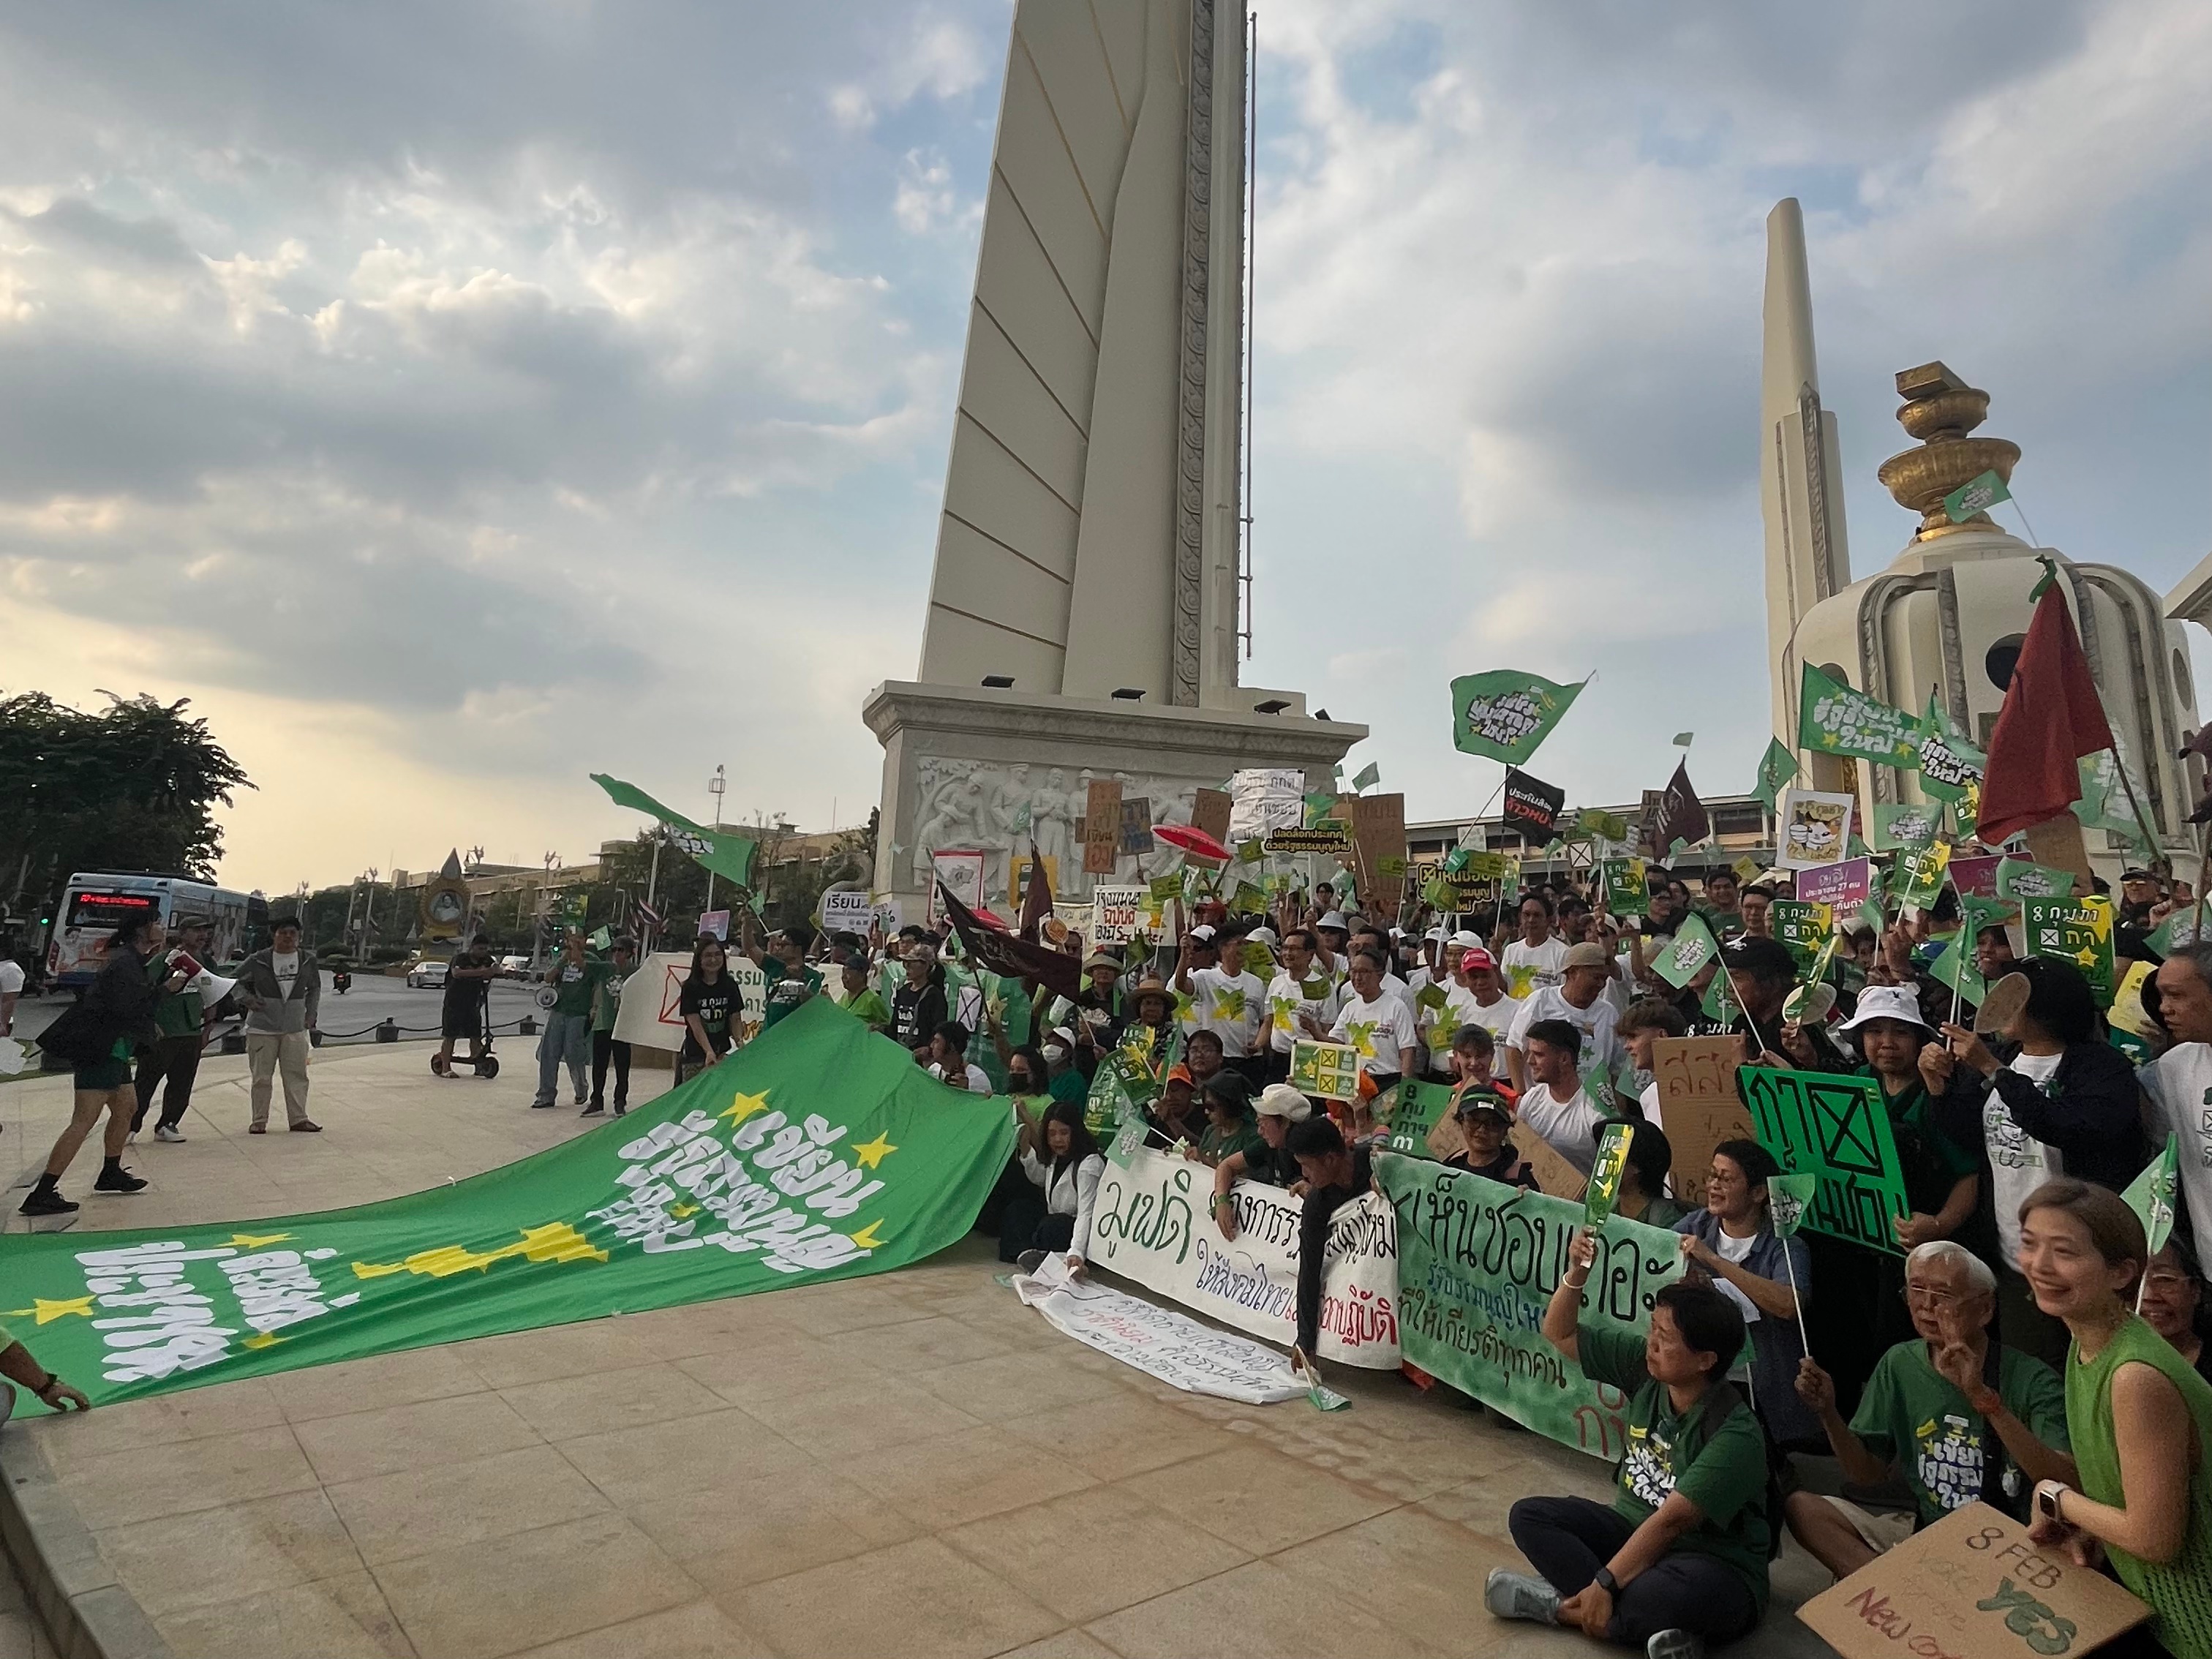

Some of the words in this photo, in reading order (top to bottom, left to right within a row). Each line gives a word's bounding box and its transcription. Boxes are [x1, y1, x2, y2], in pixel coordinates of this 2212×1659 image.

[1778, 908, 1786, 920] 8
[2032, 906, 2043, 922] 8
[2049, 907, 2099, 928] กุมภา
[1801, 925, 1821, 937] กา
[2066, 930, 2096, 946] กา
[1404, 1084, 1418, 1099] 8
[1393, 1135, 1414, 1151] กา
[1426, 1257, 1545, 1334] รัฐธรรมนูญให
[1965, 1527, 2004, 1550] 8
[1995, 1543, 2063, 1590] FEB
[1976, 1576, 2078, 1656] YES
